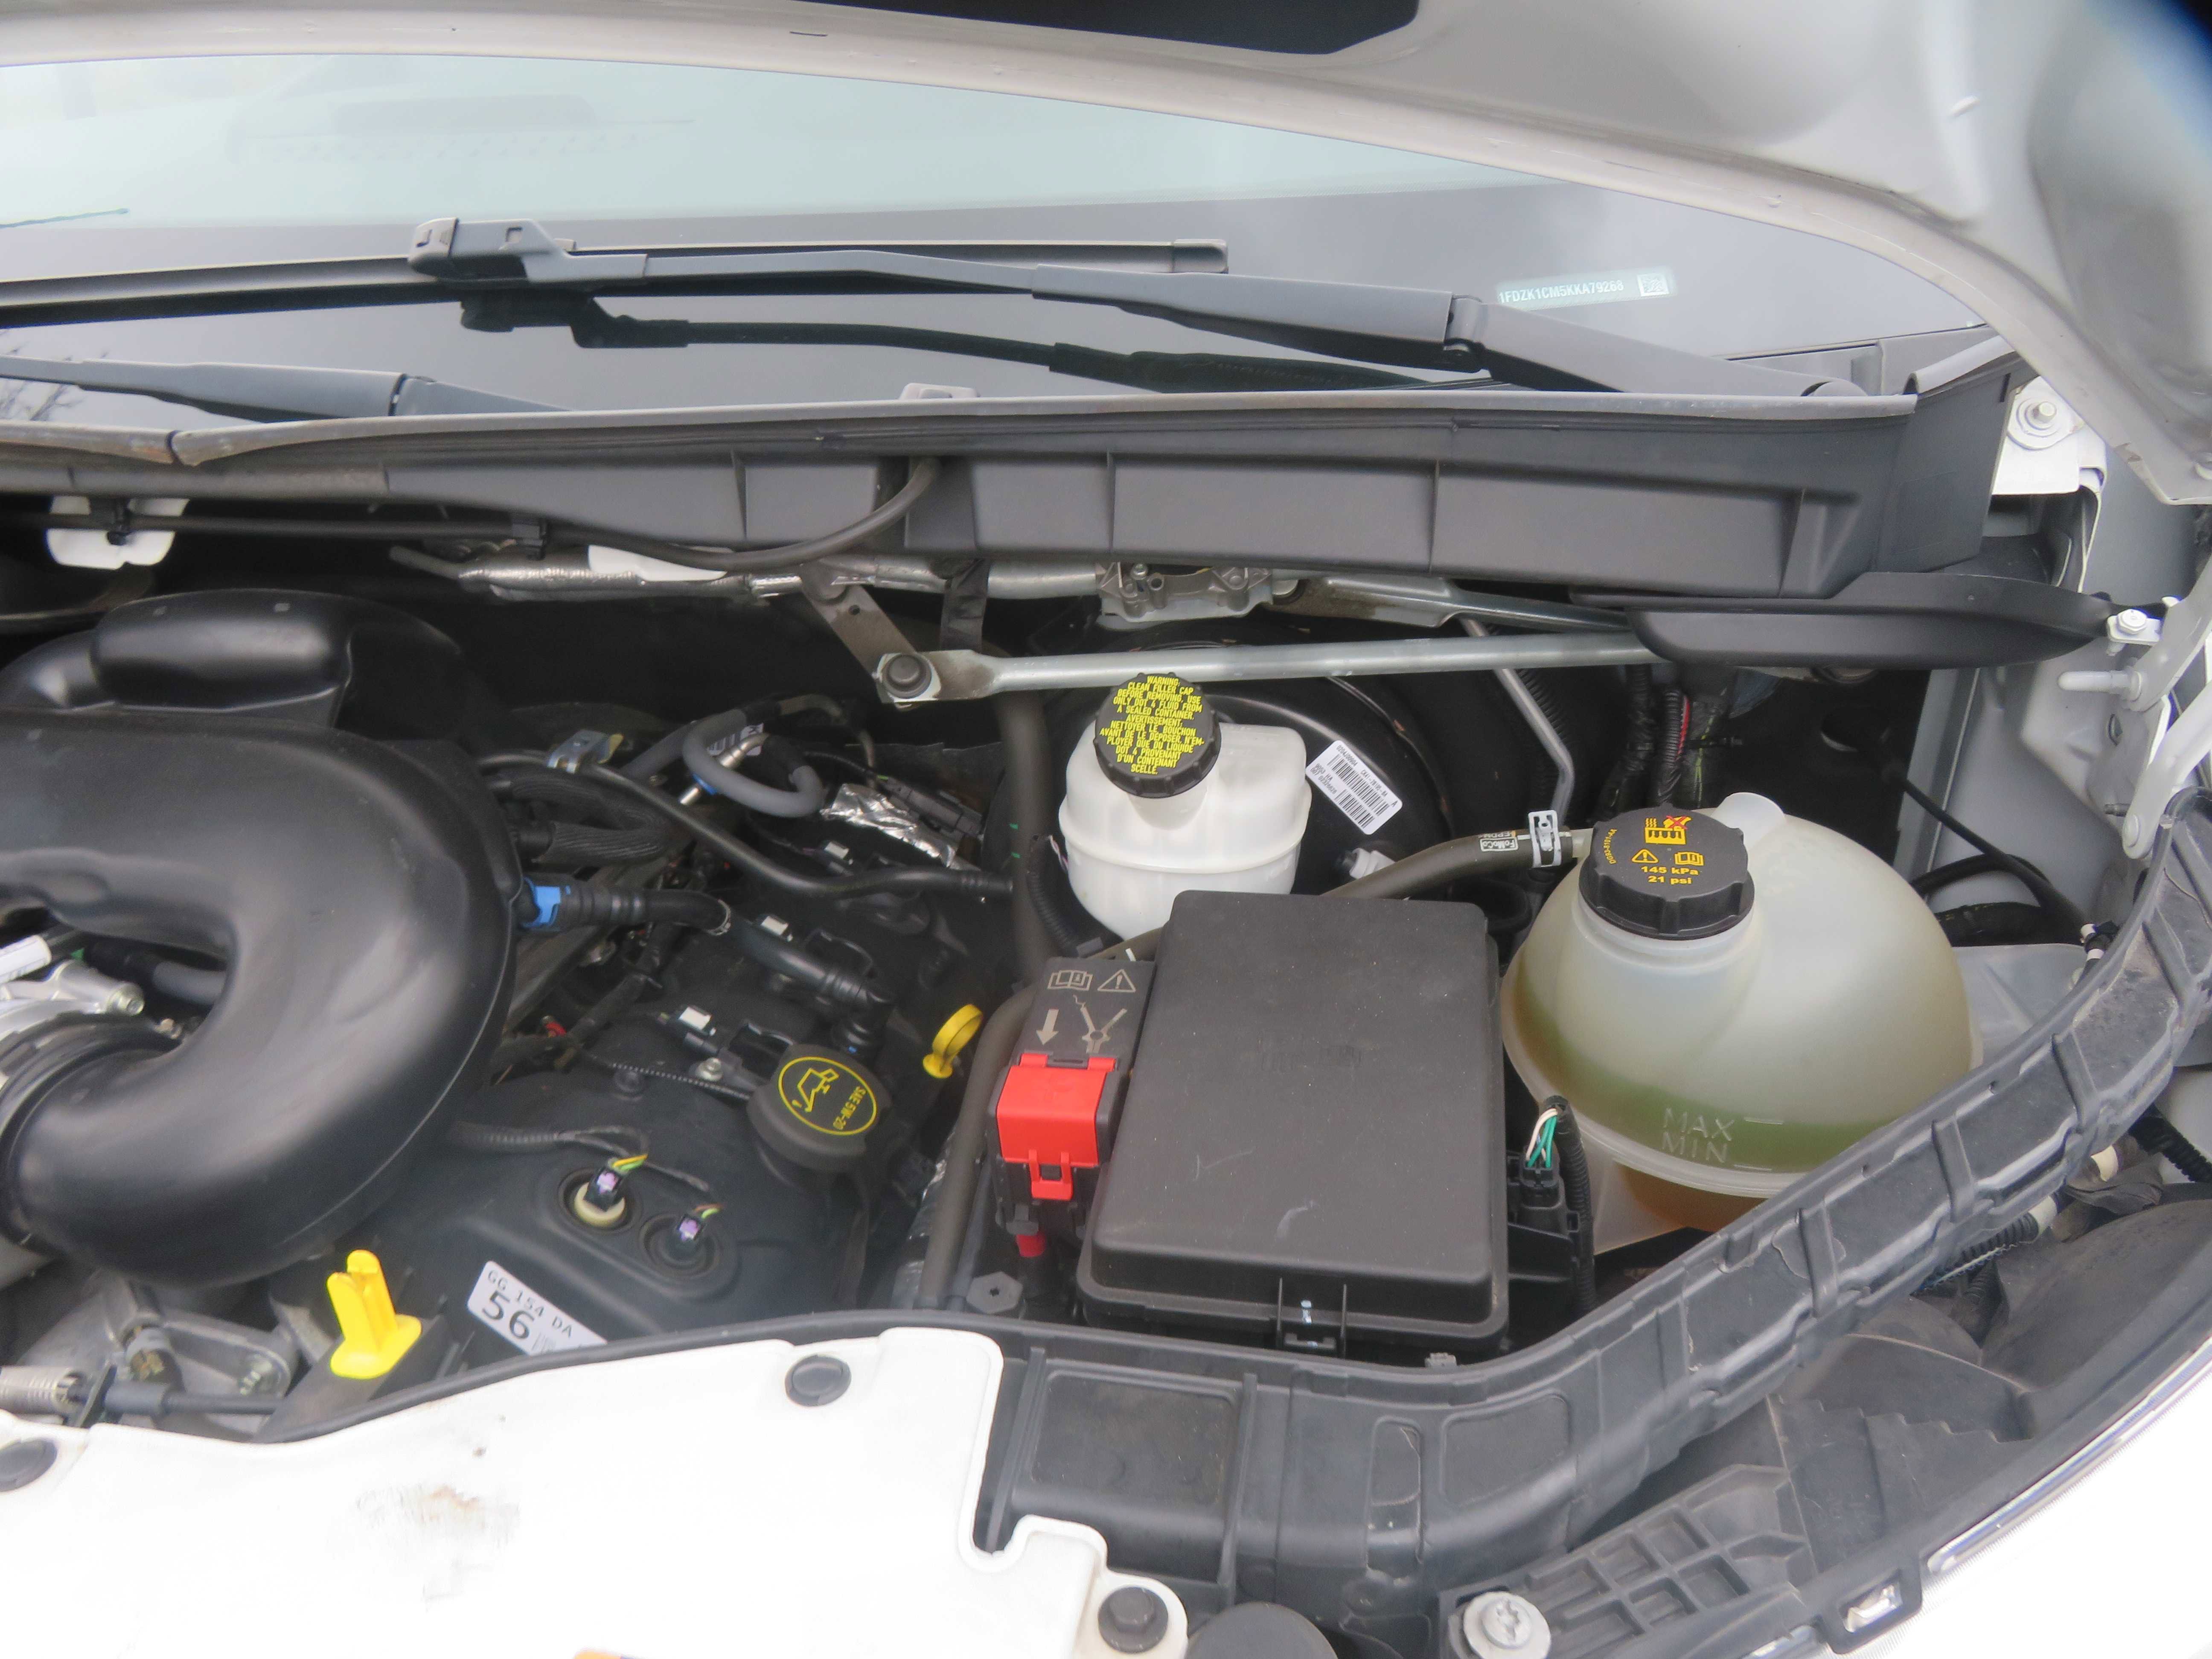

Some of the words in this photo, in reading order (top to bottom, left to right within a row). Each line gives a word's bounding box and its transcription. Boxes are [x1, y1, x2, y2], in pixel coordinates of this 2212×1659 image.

[1498, 279, 1624, 303] 1FDZK1CM5KKA79268
[1128, 682, 1150, 691] CLEAN
[1179, 687, 1194, 695] CAP
[1118, 689, 1143, 699] BEFORE
[1187, 696, 1201, 704] USE
[1113, 696, 1131, 705] ONLY
[1159, 701, 1179, 710] FLUID
[1182, 703, 1202, 713] FROM
[1126, 706, 1151, 715] SEALED
[1100, 728, 1122, 736] AVANT
[1138, 731, 1147, 739] LE
[1111, 721, 1145, 732] NETTOYER
[1163, 725, 1196, 736] BOUCHON
[1106, 737, 1133, 747] PLOYER
[1136, 739, 1150, 748] QUE
[1167, 742, 1194, 753] LIQUIDE
[1116, 745, 1129, 754] DOT
[1132, 747, 1137, 755] 4
[1141, 747, 1182, 760] PROVENANT
[1137, 756, 1178, 768] CONTENANT
[1482, 839, 1515, 849] FoMoCo
[1672, 867, 1699, 876] kPa
[850, 1086, 866, 1105] SAE
[1663, 1108, 1735, 1141] MAX
[1662, 1132, 1728, 1163] MIN
[482, 1291, 534, 1339] 56
